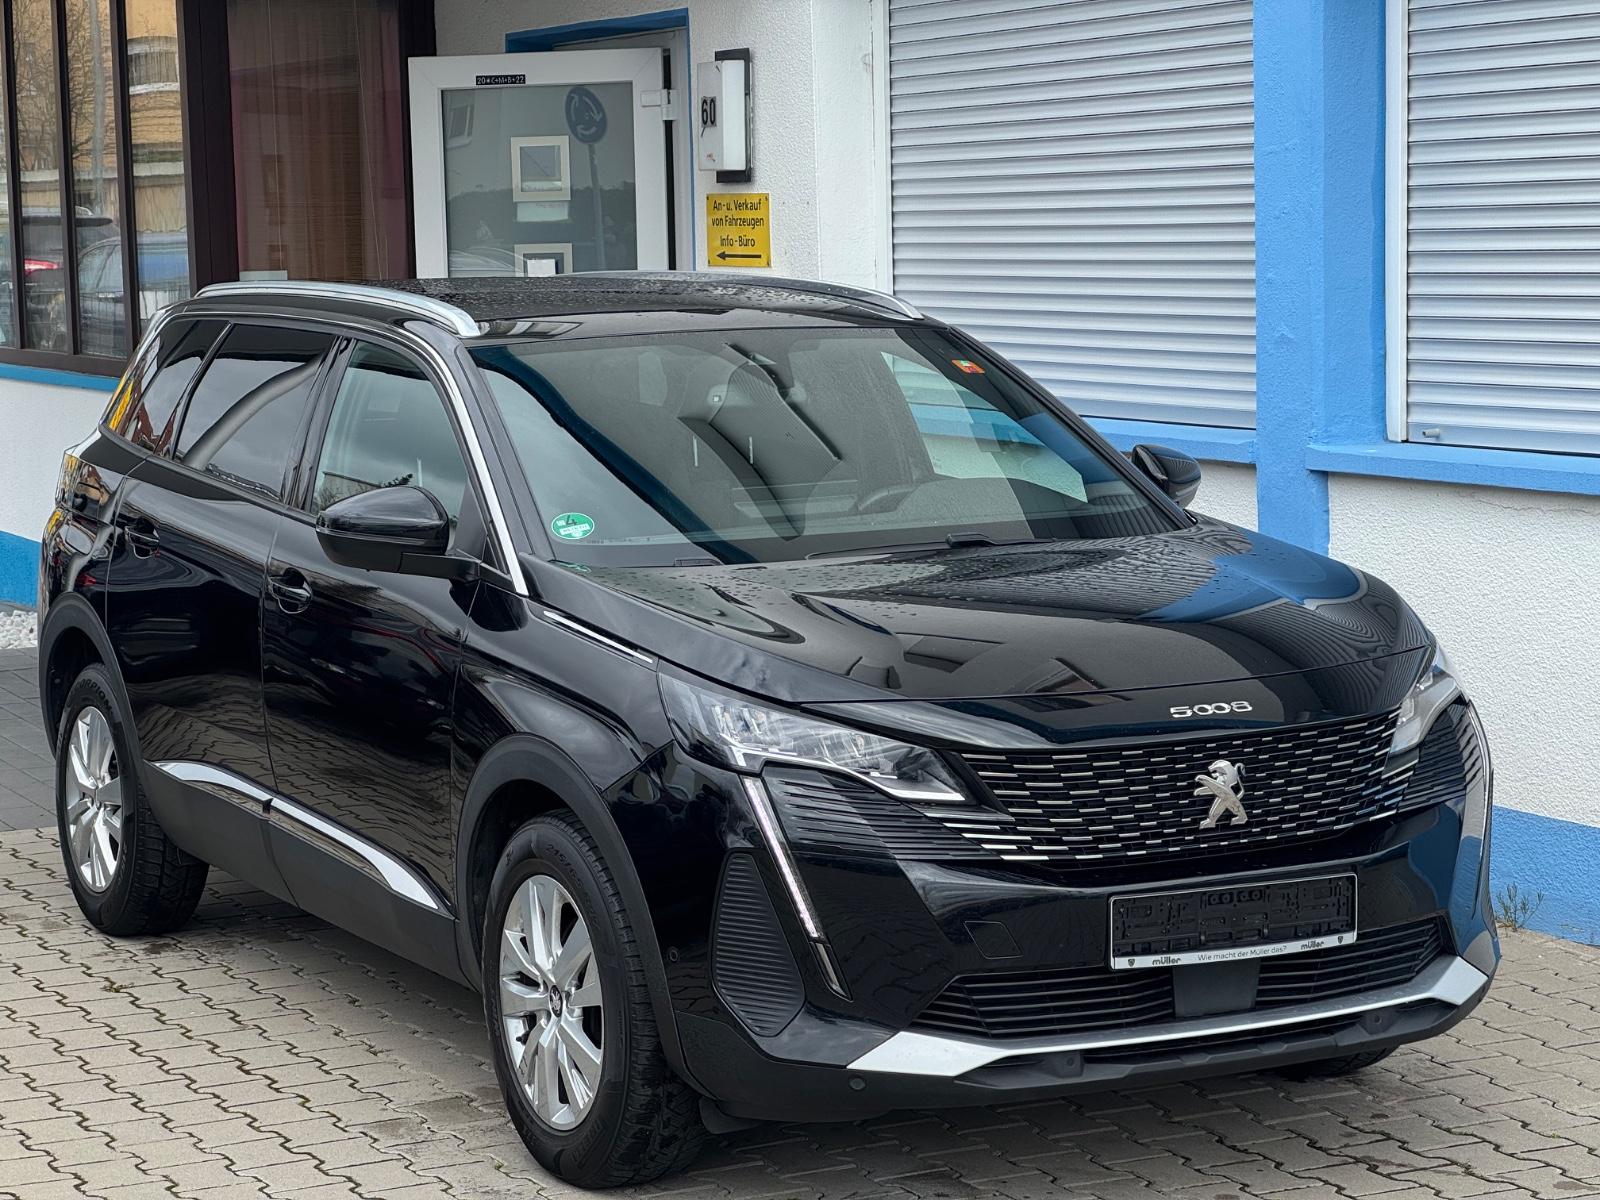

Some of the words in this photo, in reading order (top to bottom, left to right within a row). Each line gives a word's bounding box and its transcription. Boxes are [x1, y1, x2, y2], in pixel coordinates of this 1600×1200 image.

[701, 98, 716, 126] 60
[734, 199, 761, 210] Verkauf
[712, 218, 723, 226] von
[725, 215, 764, 229] Fahrzeugen
[1169, 700, 1253, 718] 5008
[1213, 951, 1236, 960] macht
[1237, 950, 1249, 958] der
[1249, 948, 1270, 957] Müller
[1270, 945, 1287, 953] das?
